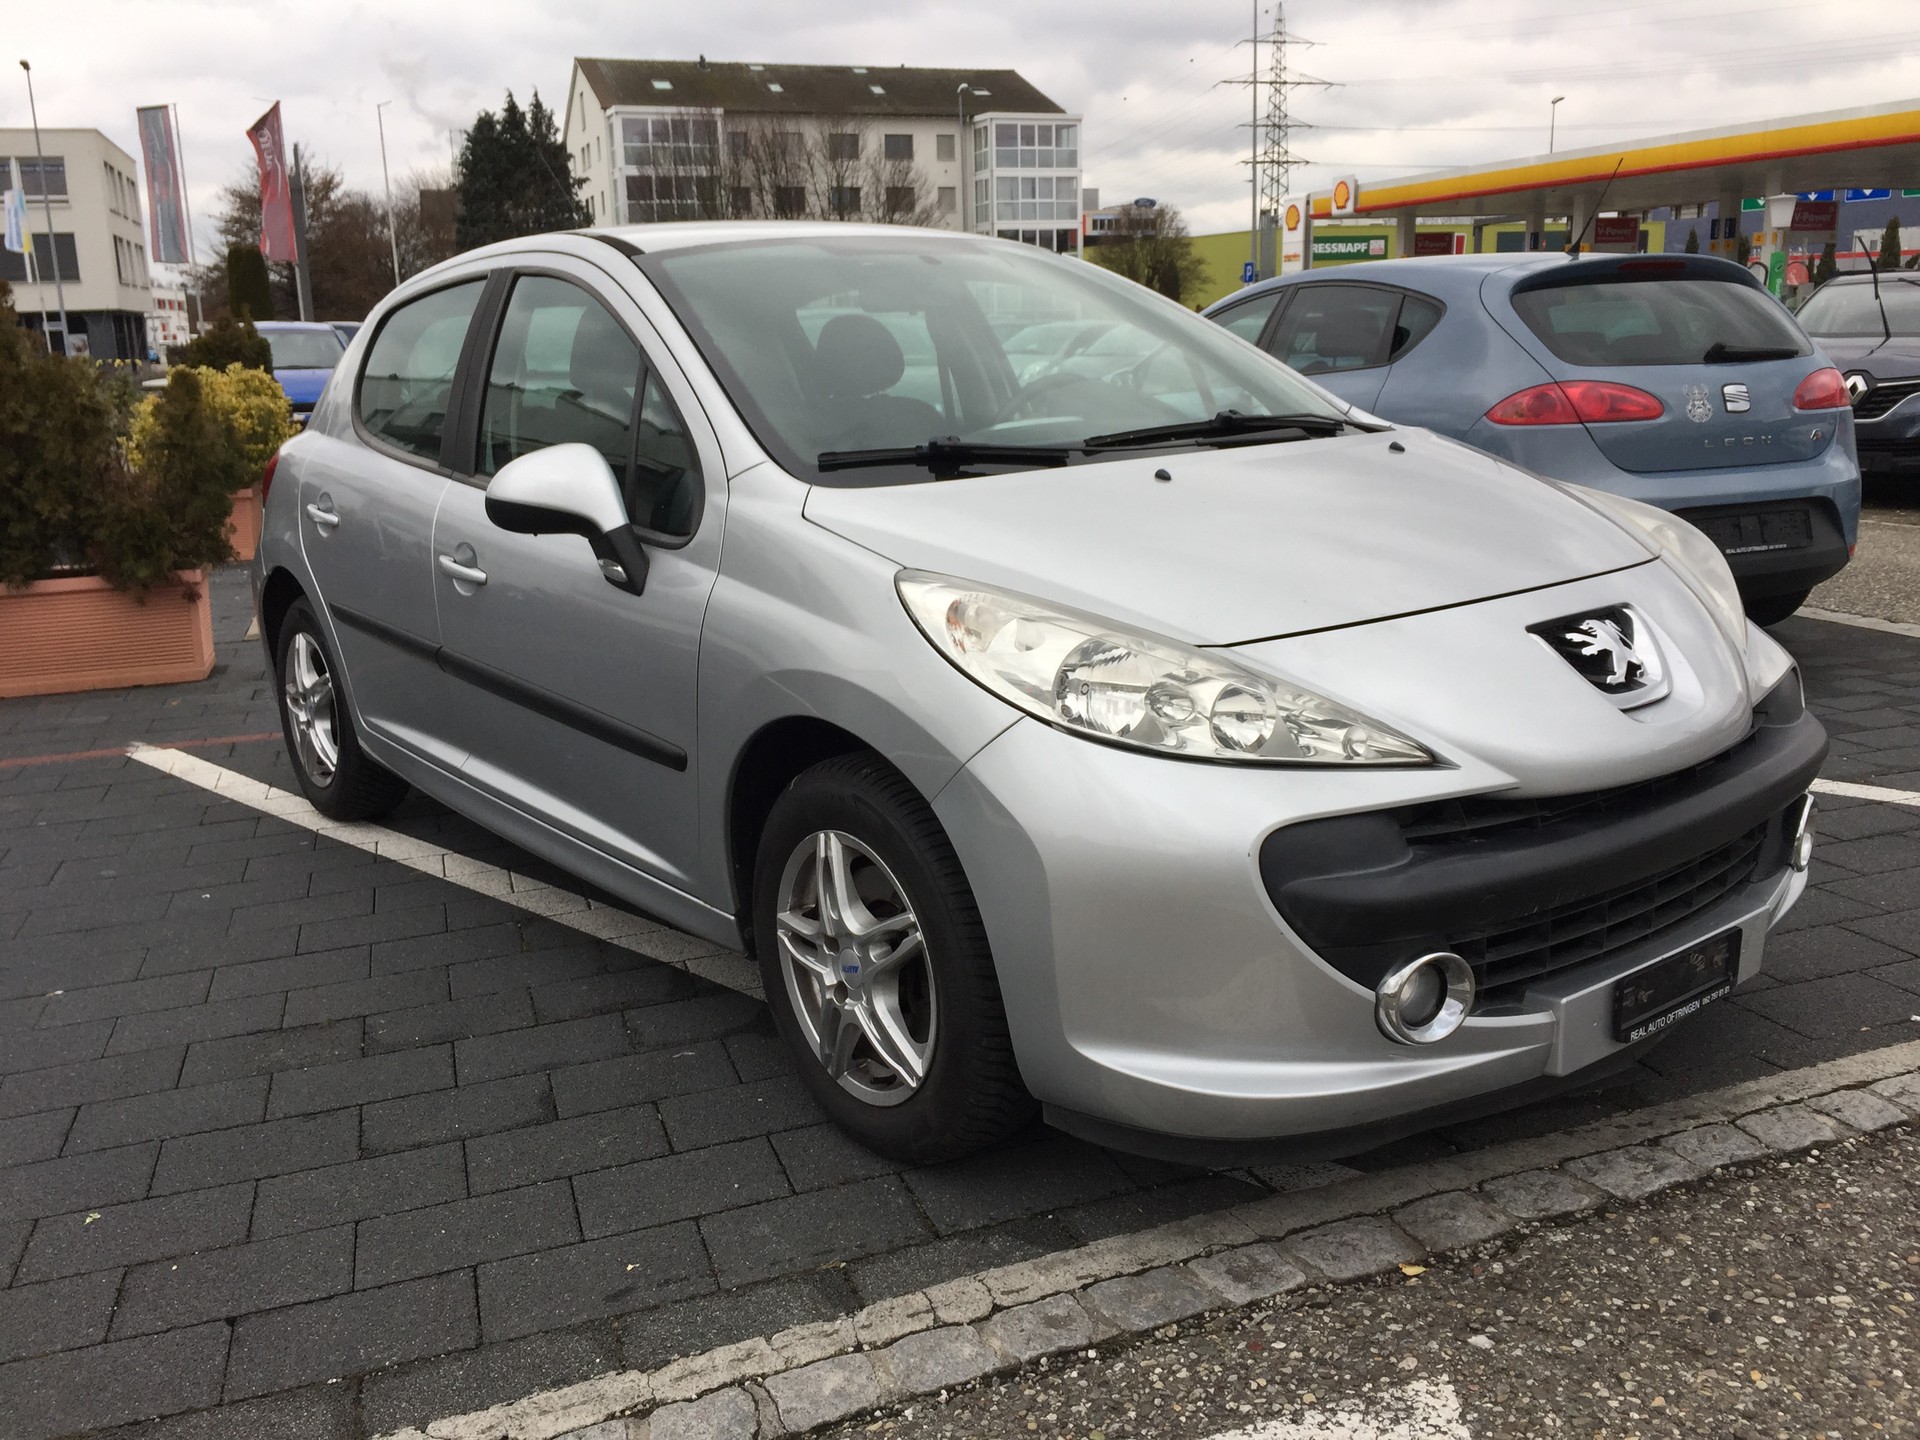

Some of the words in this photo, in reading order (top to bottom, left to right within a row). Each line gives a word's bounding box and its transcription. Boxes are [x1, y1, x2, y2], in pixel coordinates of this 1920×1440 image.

[1312, 242, 1368, 254] RESSNAPF
[1245, 265, 1253, 282] P
[1704, 435, 1773, 448] LEON
[1630, 1026, 1647, 1042] REAL
[1648, 1016, 1666, 1033] AUTO
[1666, 999, 1701, 1024] OFTRINGEN
